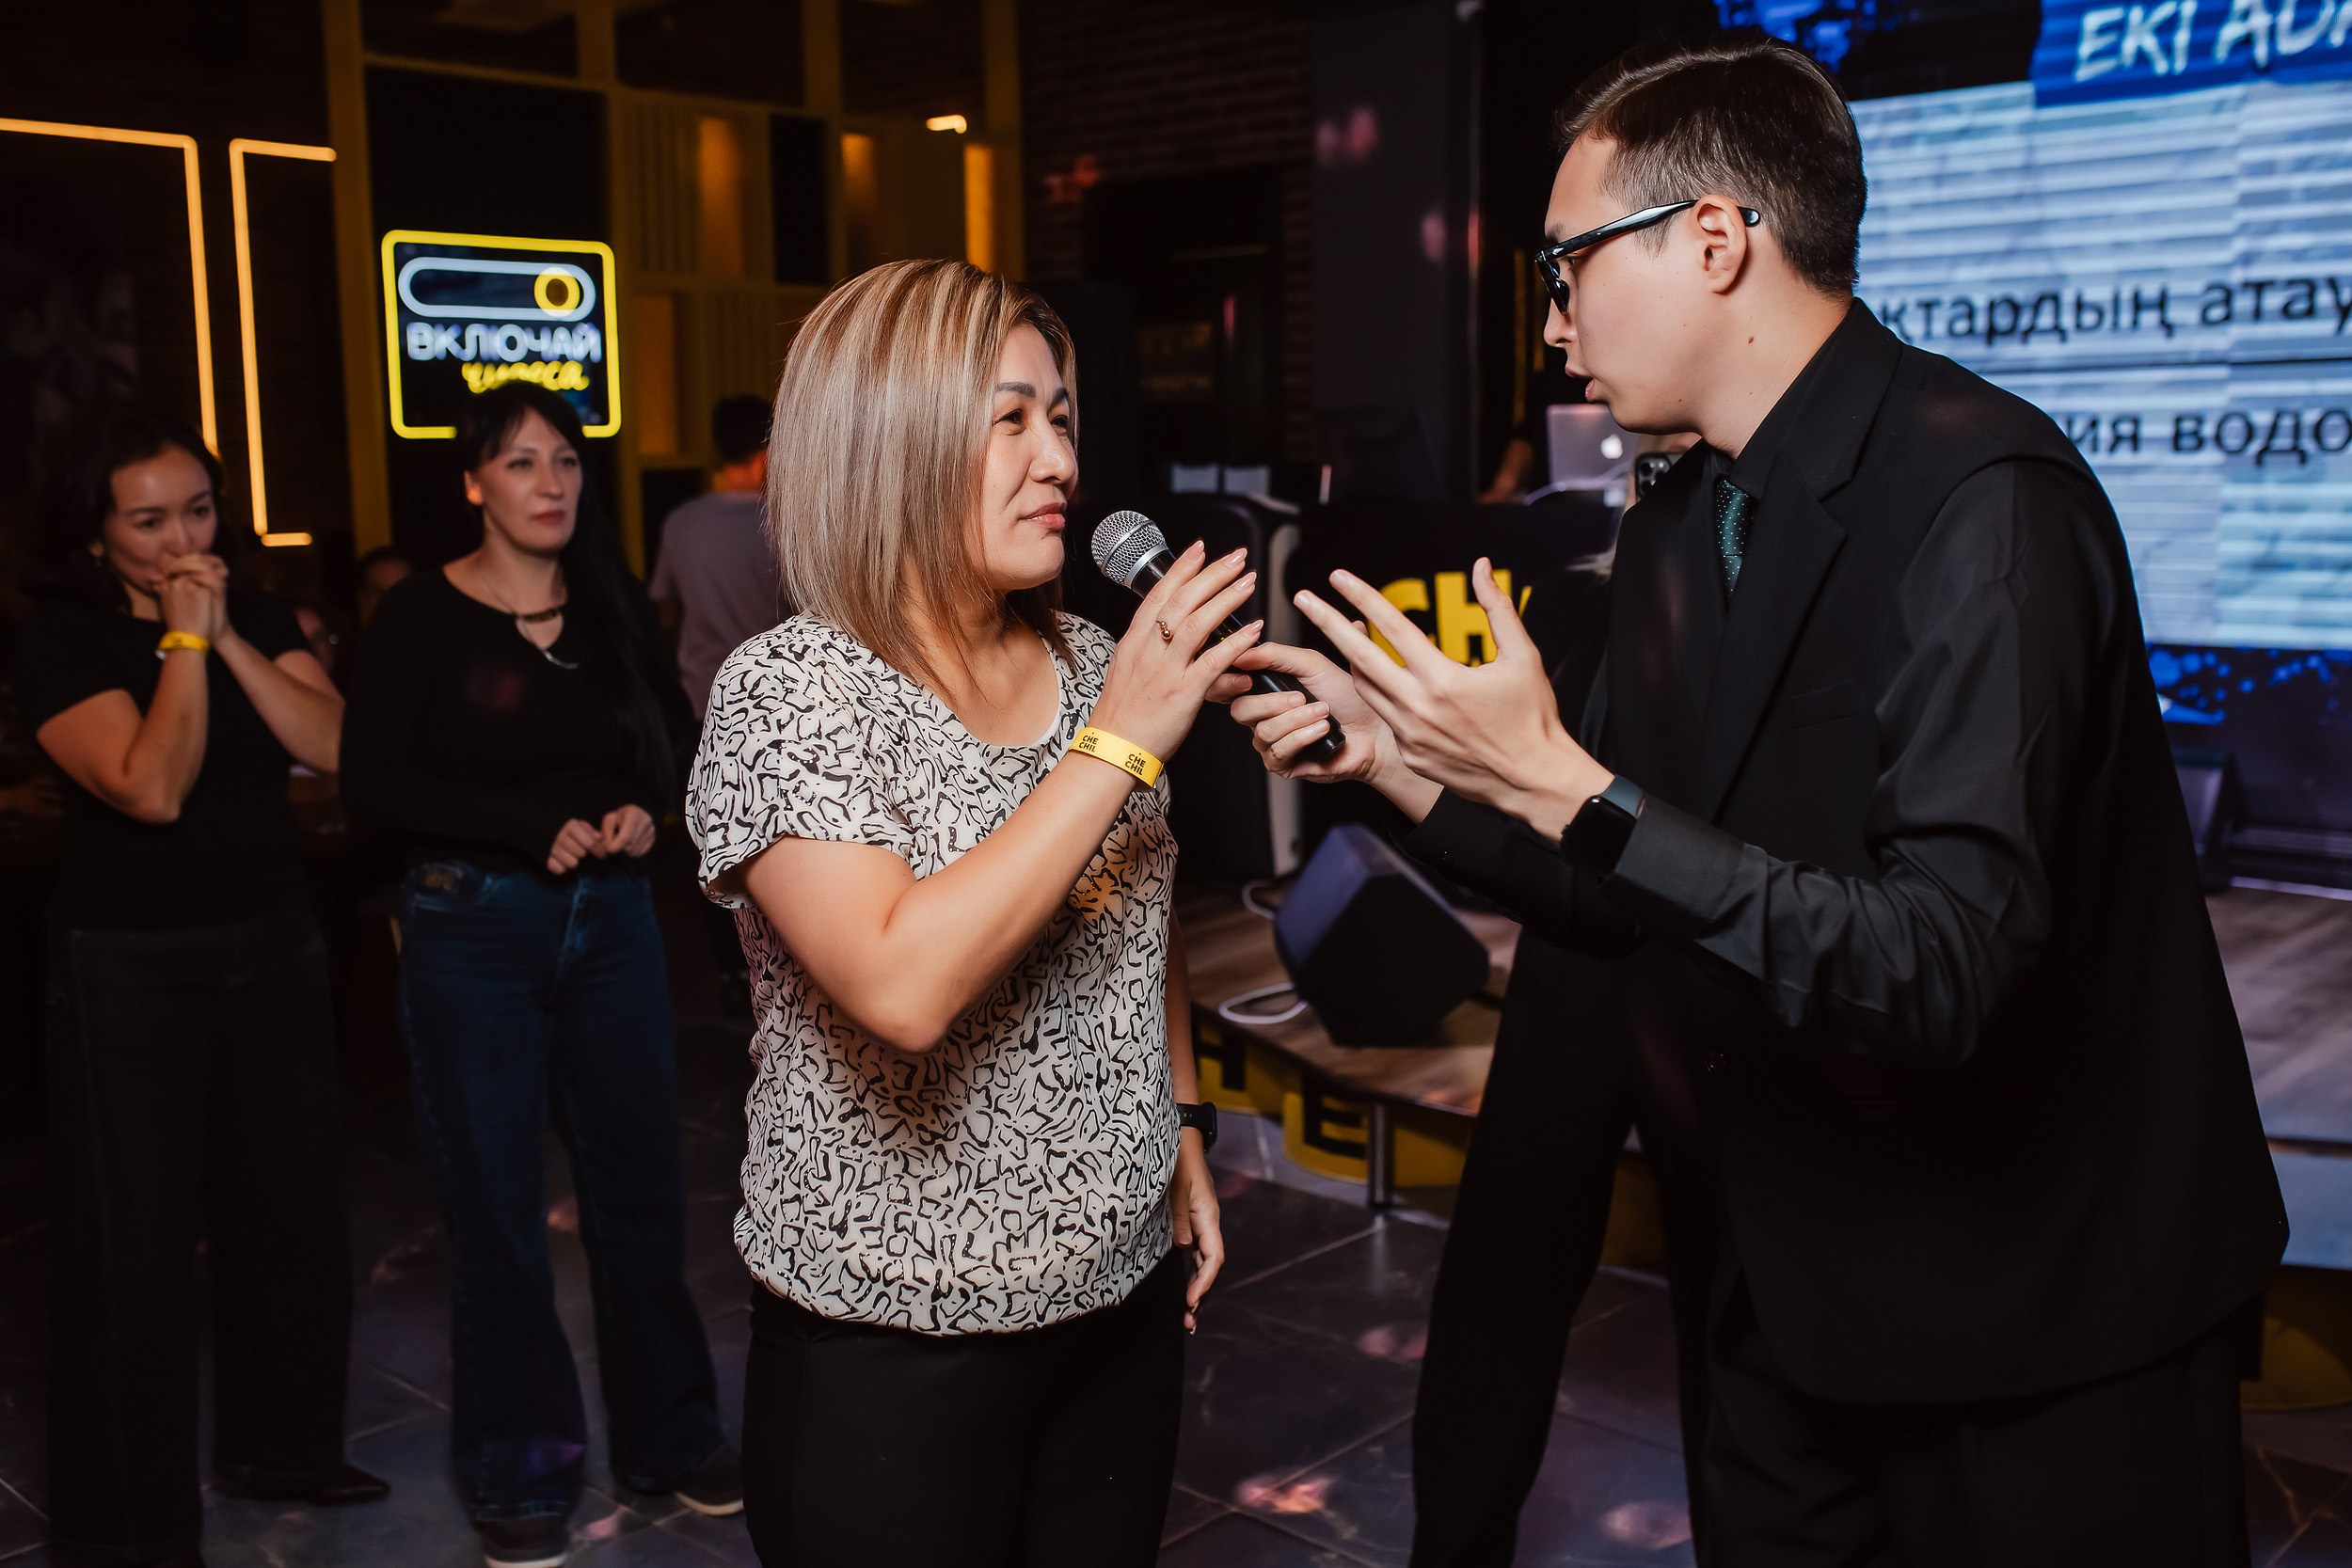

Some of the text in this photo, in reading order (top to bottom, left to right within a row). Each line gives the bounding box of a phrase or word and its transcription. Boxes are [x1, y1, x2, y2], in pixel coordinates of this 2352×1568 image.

[406, 322, 602, 363] ВКЛЮЧАЙ
[1366, 568, 1533, 666] CH
[1078, 741, 1096, 752] CHIL
[1082, 735, 1099, 745] CHE
[1124, 760, 1143, 776] CHIL
[1128, 753, 1146, 768] CHE
